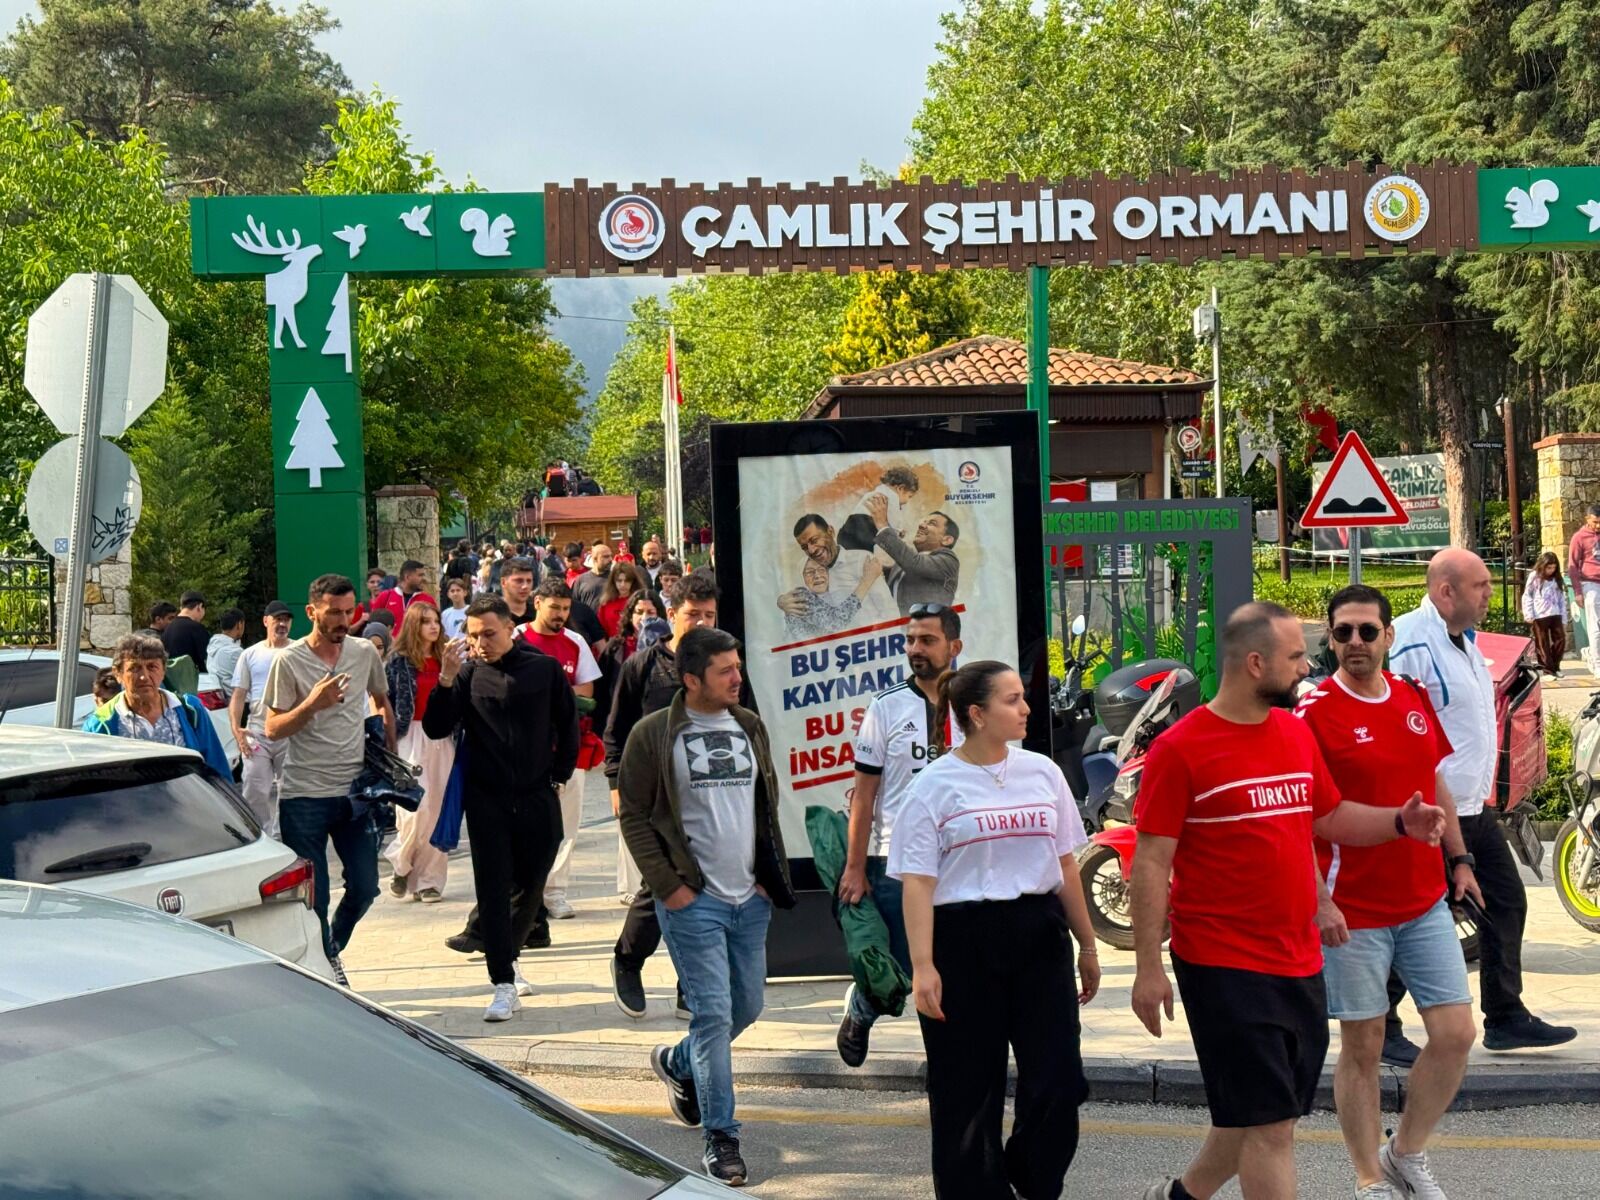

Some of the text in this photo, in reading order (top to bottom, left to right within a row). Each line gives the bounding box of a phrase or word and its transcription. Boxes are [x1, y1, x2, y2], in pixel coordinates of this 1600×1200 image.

[681, 202, 909, 257] ÇAMLIK
[922, 189, 1097, 254] ŞEHİR
[1112, 188, 1348, 240] ORMANI
[791, 633, 906, 678] BU ŞEHR
[805, 711, 844, 741] BU
[789, 741, 855, 776] İNSA
[912, 741, 939, 761] be
[690, 780, 752, 789] UNDER ARMOUR
[1247, 782, 1308, 808] TÜRKİYE
[975, 811, 1049, 832] TÜRKİYE
[164, 895, 178, 910] FIAT
